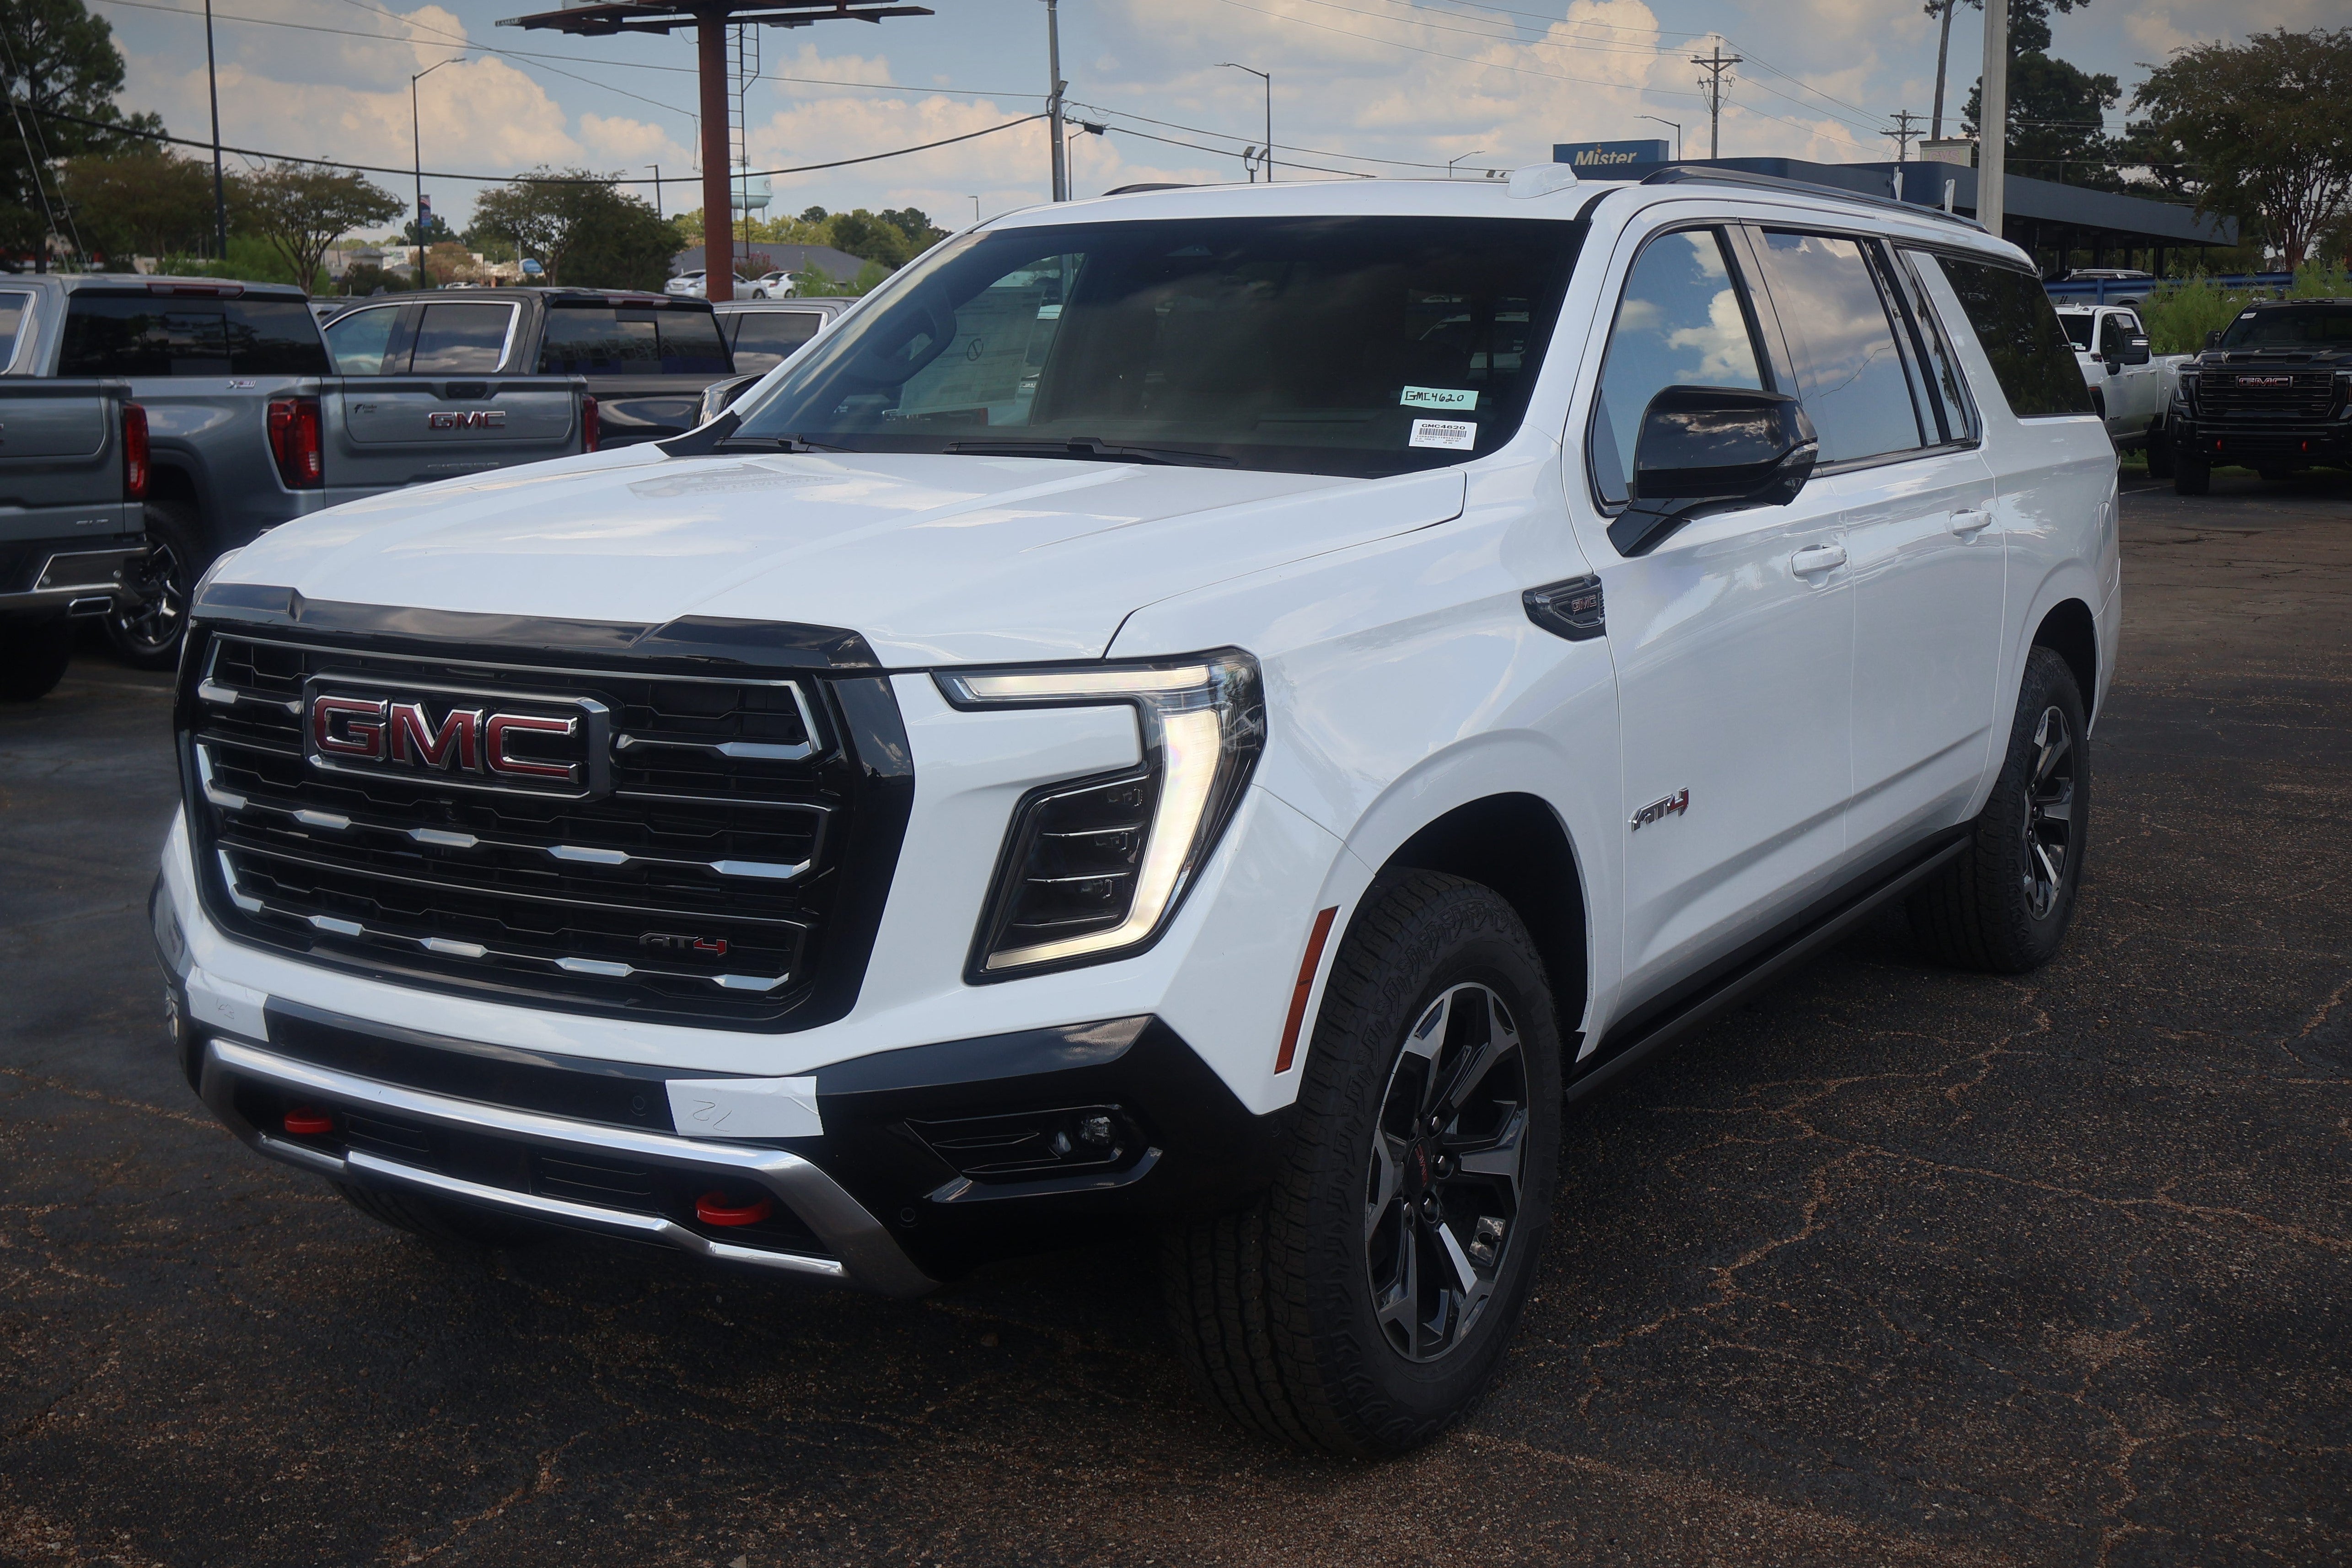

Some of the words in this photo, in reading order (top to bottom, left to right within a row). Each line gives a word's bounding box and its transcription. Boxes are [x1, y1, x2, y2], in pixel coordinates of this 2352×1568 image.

[1574, 146, 1637, 166] Mister
[1928, 150, 1960, 163] CVS
[2239, 378, 2288, 387] GMC
[1405, 391, 1464, 403] GMC4620
[429, 411, 506, 429] GMC
[1572, 595, 1597, 612] GMC
[313, 695, 579, 784] GMC
[1628, 787, 1689, 832] AT4
[639, 931, 727, 956] AT4
[1414, 1144, 1427, 1187] GMC
